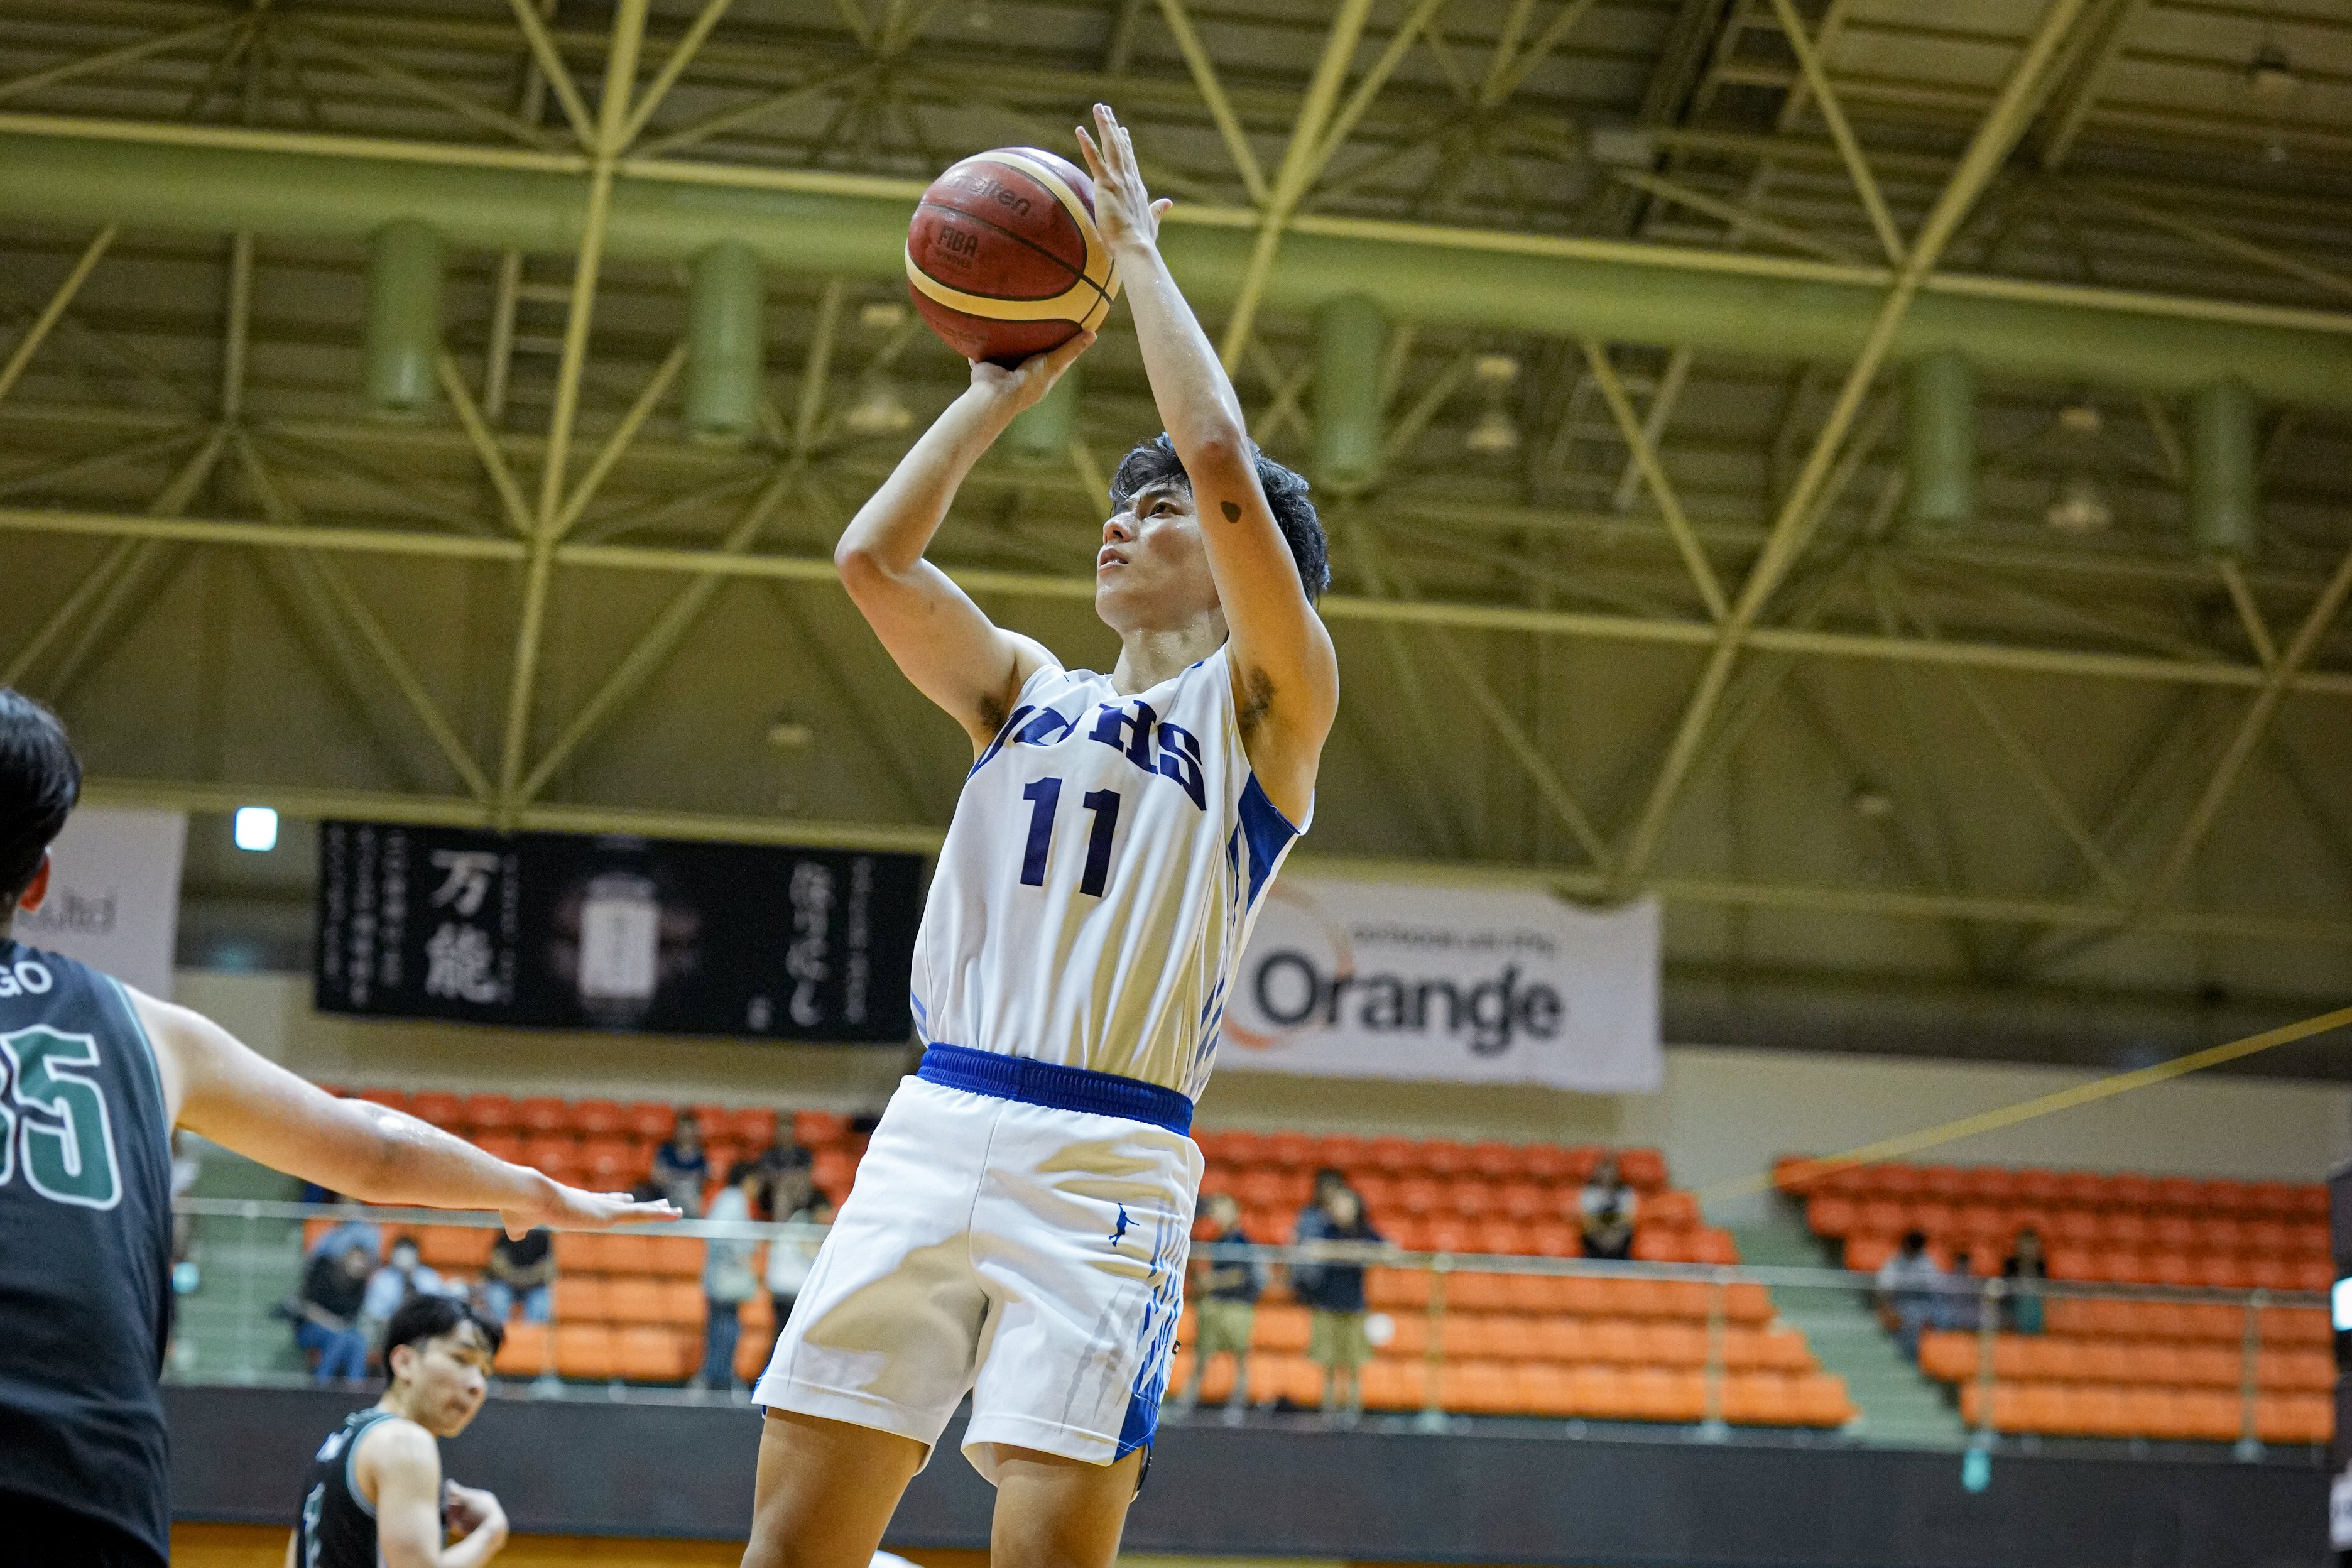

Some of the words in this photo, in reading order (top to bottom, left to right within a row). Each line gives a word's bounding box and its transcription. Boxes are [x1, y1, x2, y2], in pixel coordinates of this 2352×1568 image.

[937, 225, 979, 258] FIBA
[1020, 776, 1121, 898] 11
[425, 849, 503, 1003] 万能
[1253, 949, 1564, 1057] Orange
[0, 1024, 123, 1211] 5
